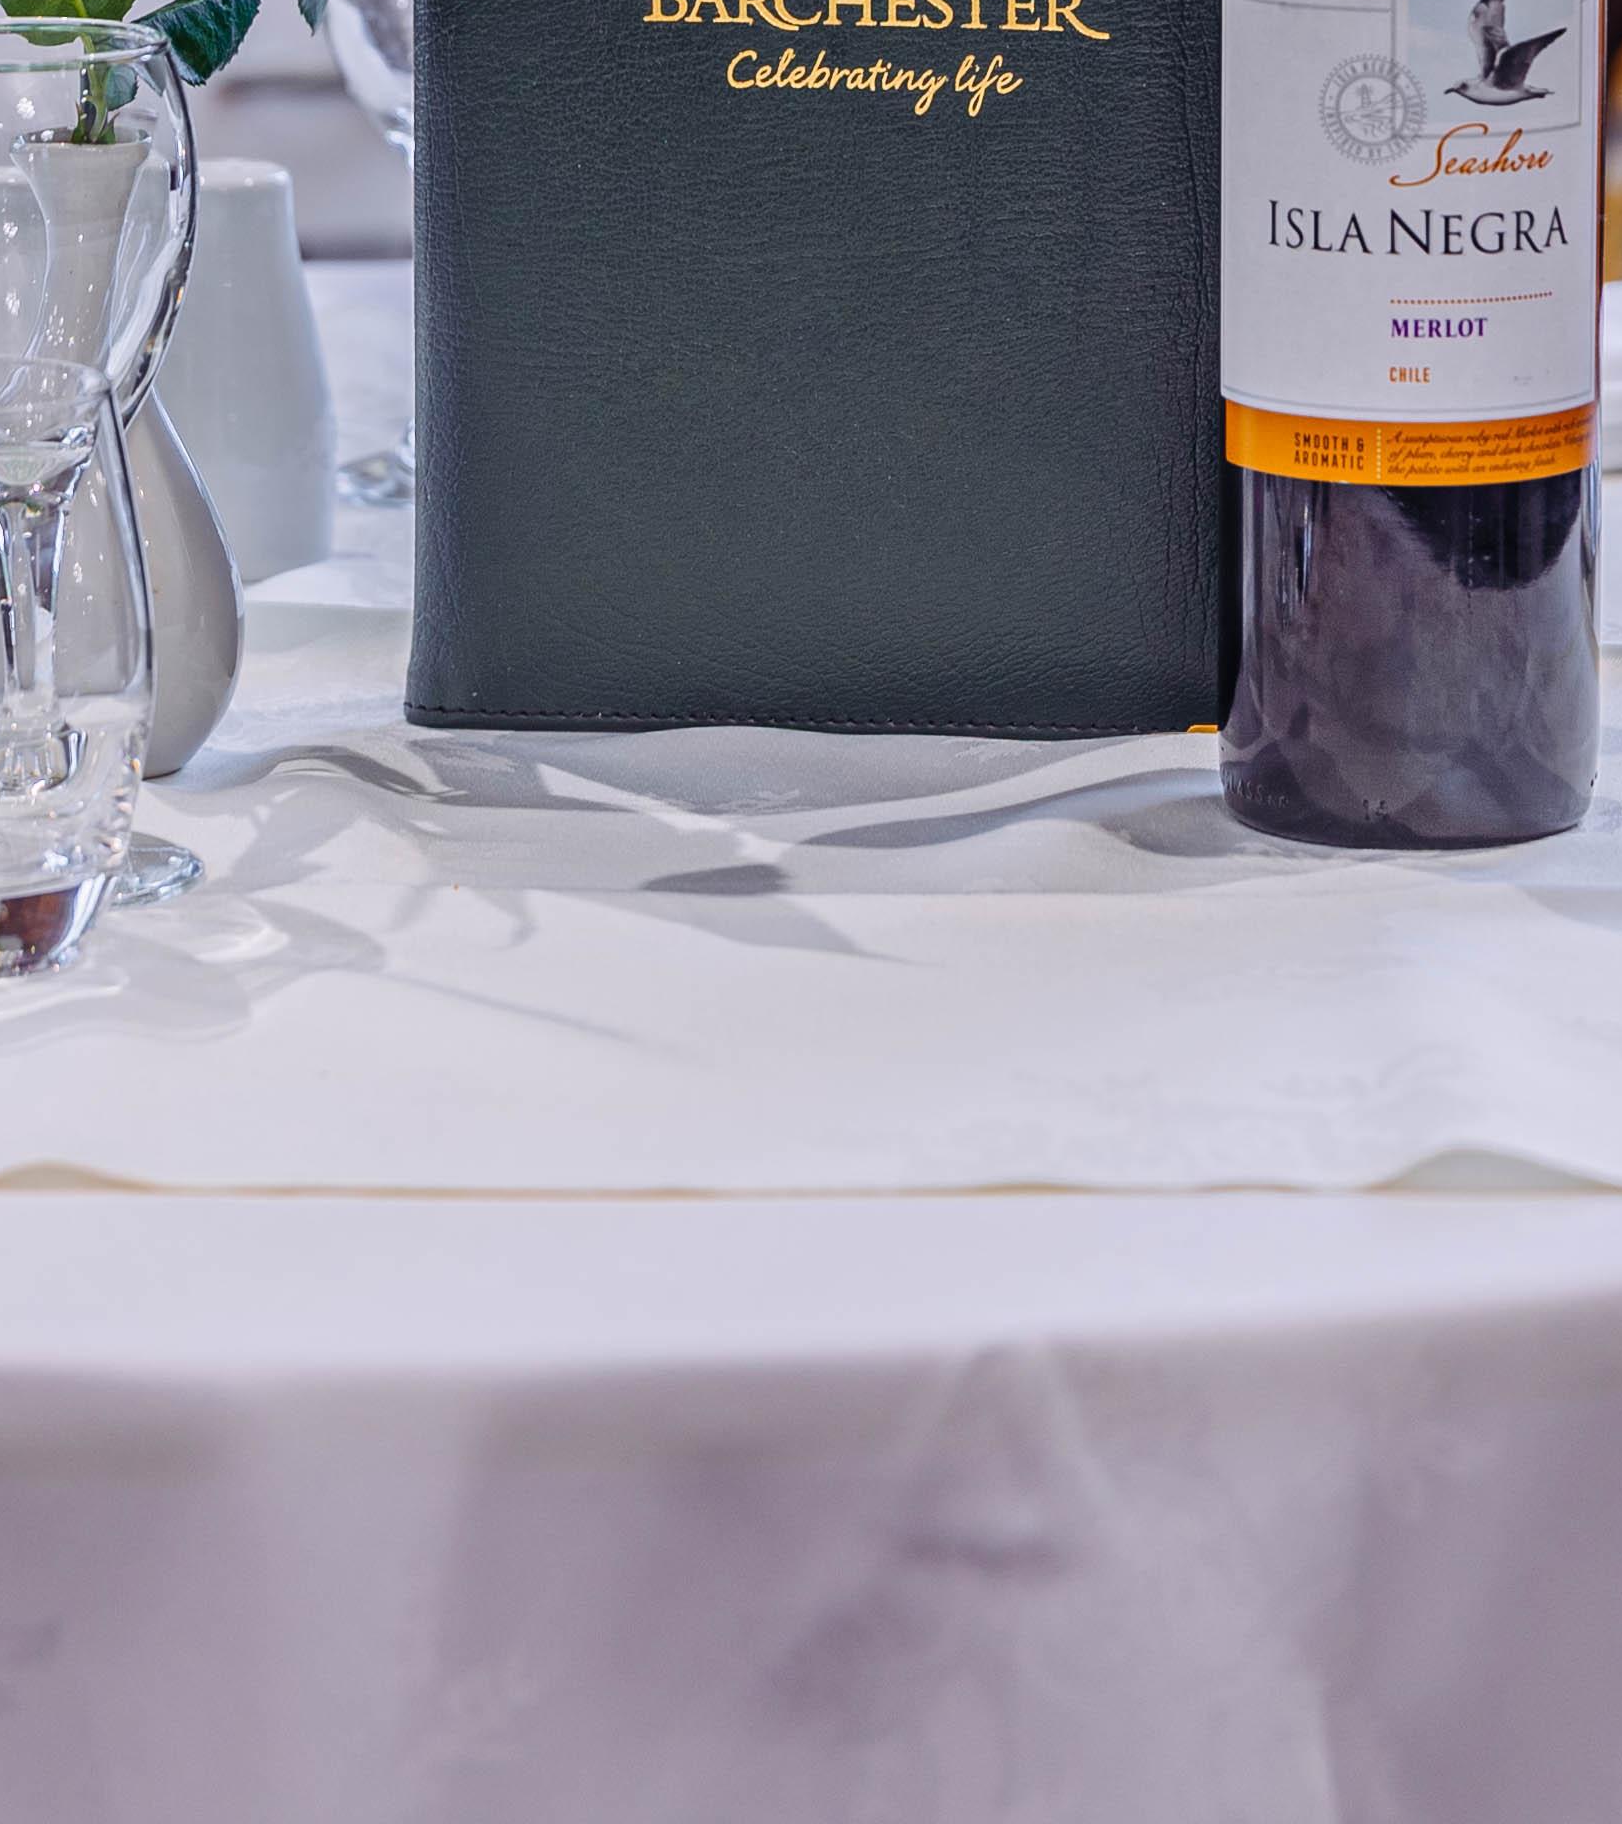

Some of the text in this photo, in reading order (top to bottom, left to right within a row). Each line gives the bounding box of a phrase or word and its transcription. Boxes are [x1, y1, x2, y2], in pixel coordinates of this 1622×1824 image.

[726, 47, 1024, 118] Celebrating life
[1389, 123, 1553, 186] Seashore
[1269, 199, 1568, 256] ISLA NEGRA
[1391, 317, 1488, 339] MERLOT
[1389, 366, 1431, 384] CHILE
[1294, 432, 1349, 451] SMOOTH
[1294, 450, 1365, 471] AROMATIC
